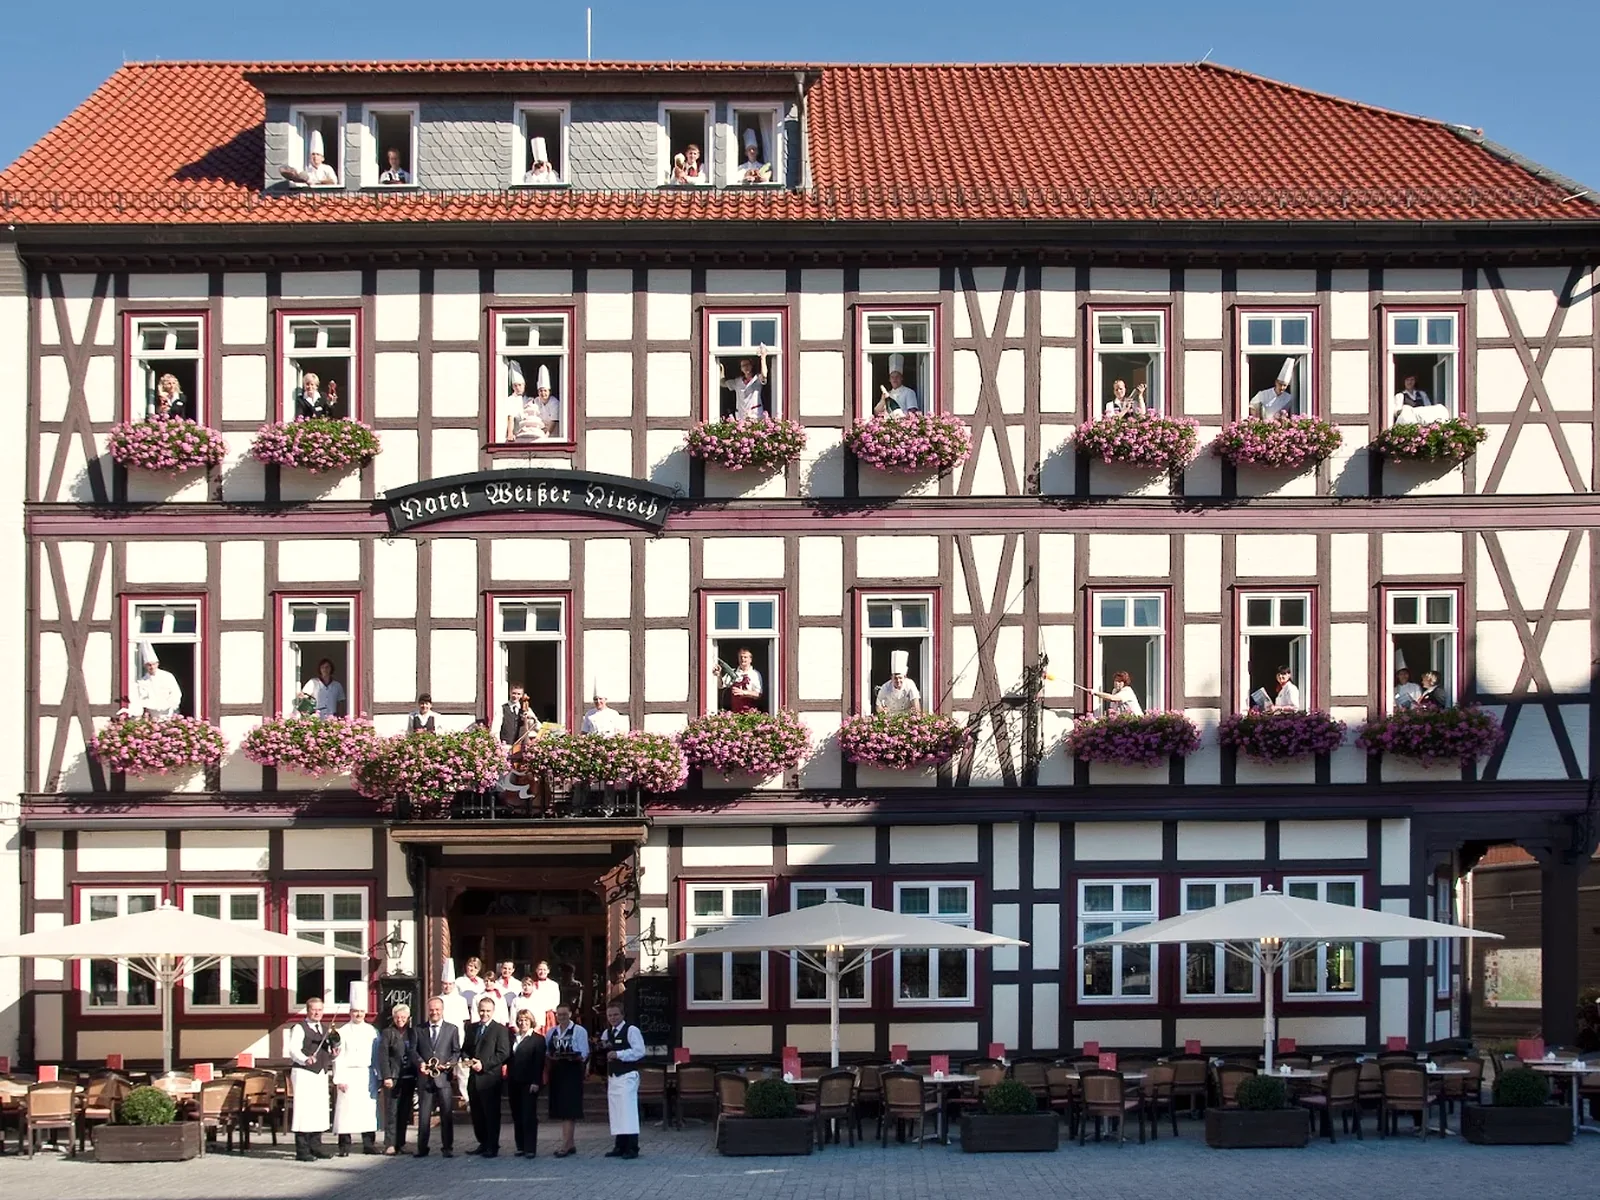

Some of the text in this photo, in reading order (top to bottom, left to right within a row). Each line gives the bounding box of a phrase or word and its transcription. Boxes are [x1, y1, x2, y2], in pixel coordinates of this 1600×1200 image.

[400, 481, 659, 521] Hotel Weißer Hirsch
